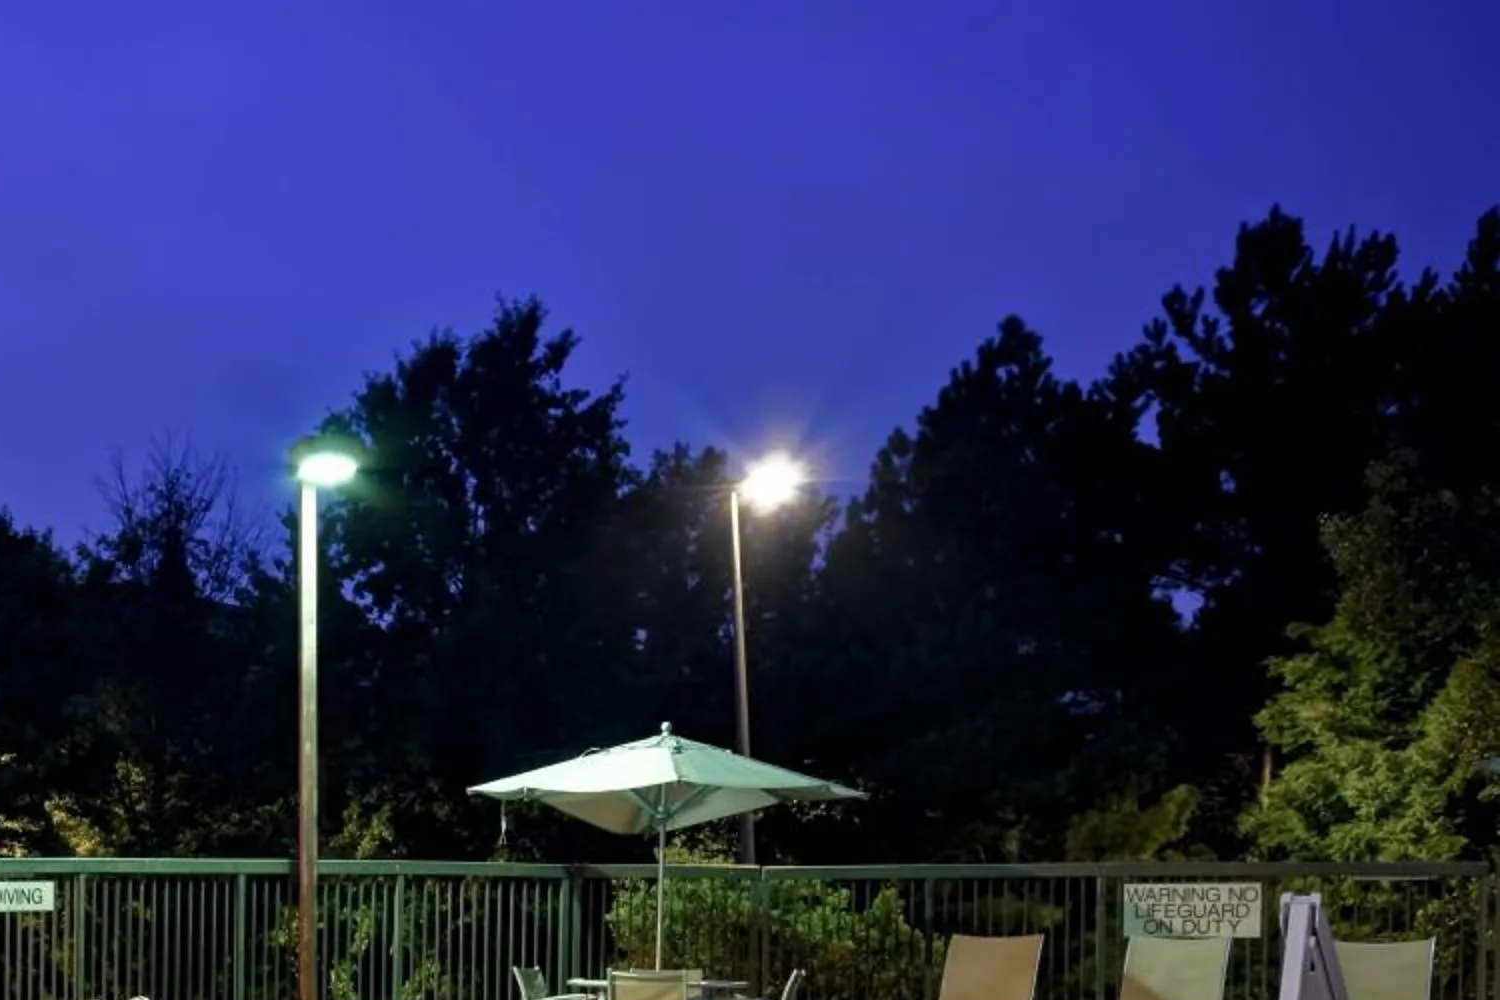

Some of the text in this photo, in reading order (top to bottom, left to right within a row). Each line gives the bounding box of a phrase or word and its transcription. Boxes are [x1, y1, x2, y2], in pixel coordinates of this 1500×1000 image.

[1126, 887, 1258, 902] WARNING NO
[1134, 903, 1250, 919] LIFEGUARD
[1143, 919, 1242, 934] ON DUTY
